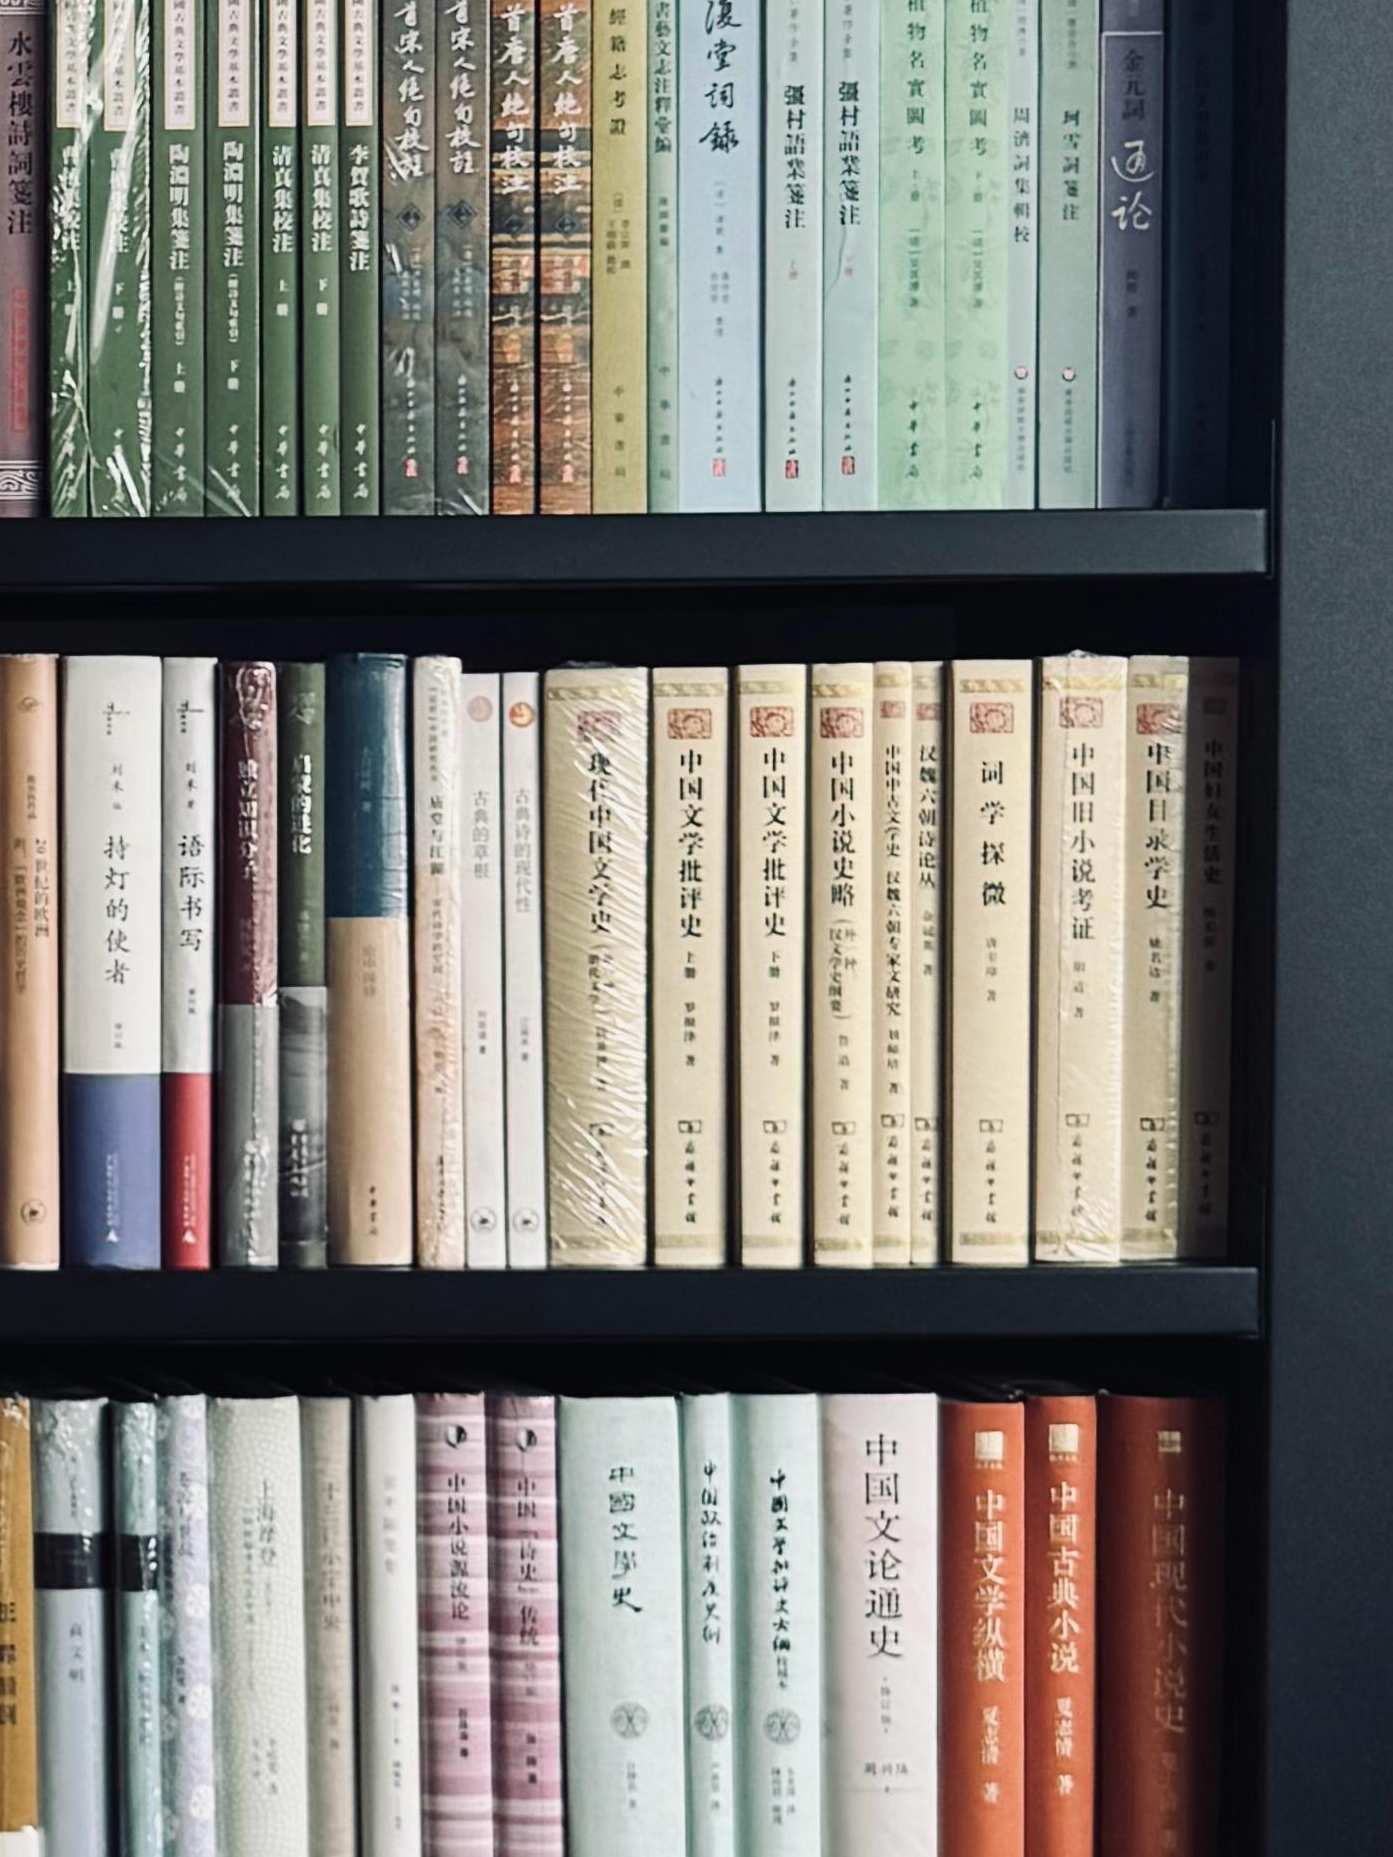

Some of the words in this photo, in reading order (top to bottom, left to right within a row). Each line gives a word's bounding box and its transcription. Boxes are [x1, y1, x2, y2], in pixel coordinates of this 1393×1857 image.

[178, 834, 206, 951] 语际书写
[471, 790, 491, 881] 古典的草根
[514, 789, 532, 914] 古典诗的现代性
[678, 749, 704, 938] 中国文学批评史
[830, 752, 857, 906] 中国小说史略
[980, 761, 1007, 906] 词学探微
[1071, 742, 1096, 941] 中国旧小说考证
[1145, 743, 1172, 910] 中国目录学史
[103, 834, 132, 986] 持灯的使者
[863, 1432, 904, 1661] 中国文论通史
[973, 1489, 1004, 1683] 中国文学纵横
[1048, 1481, 1080, 1675] 中国古典小说
